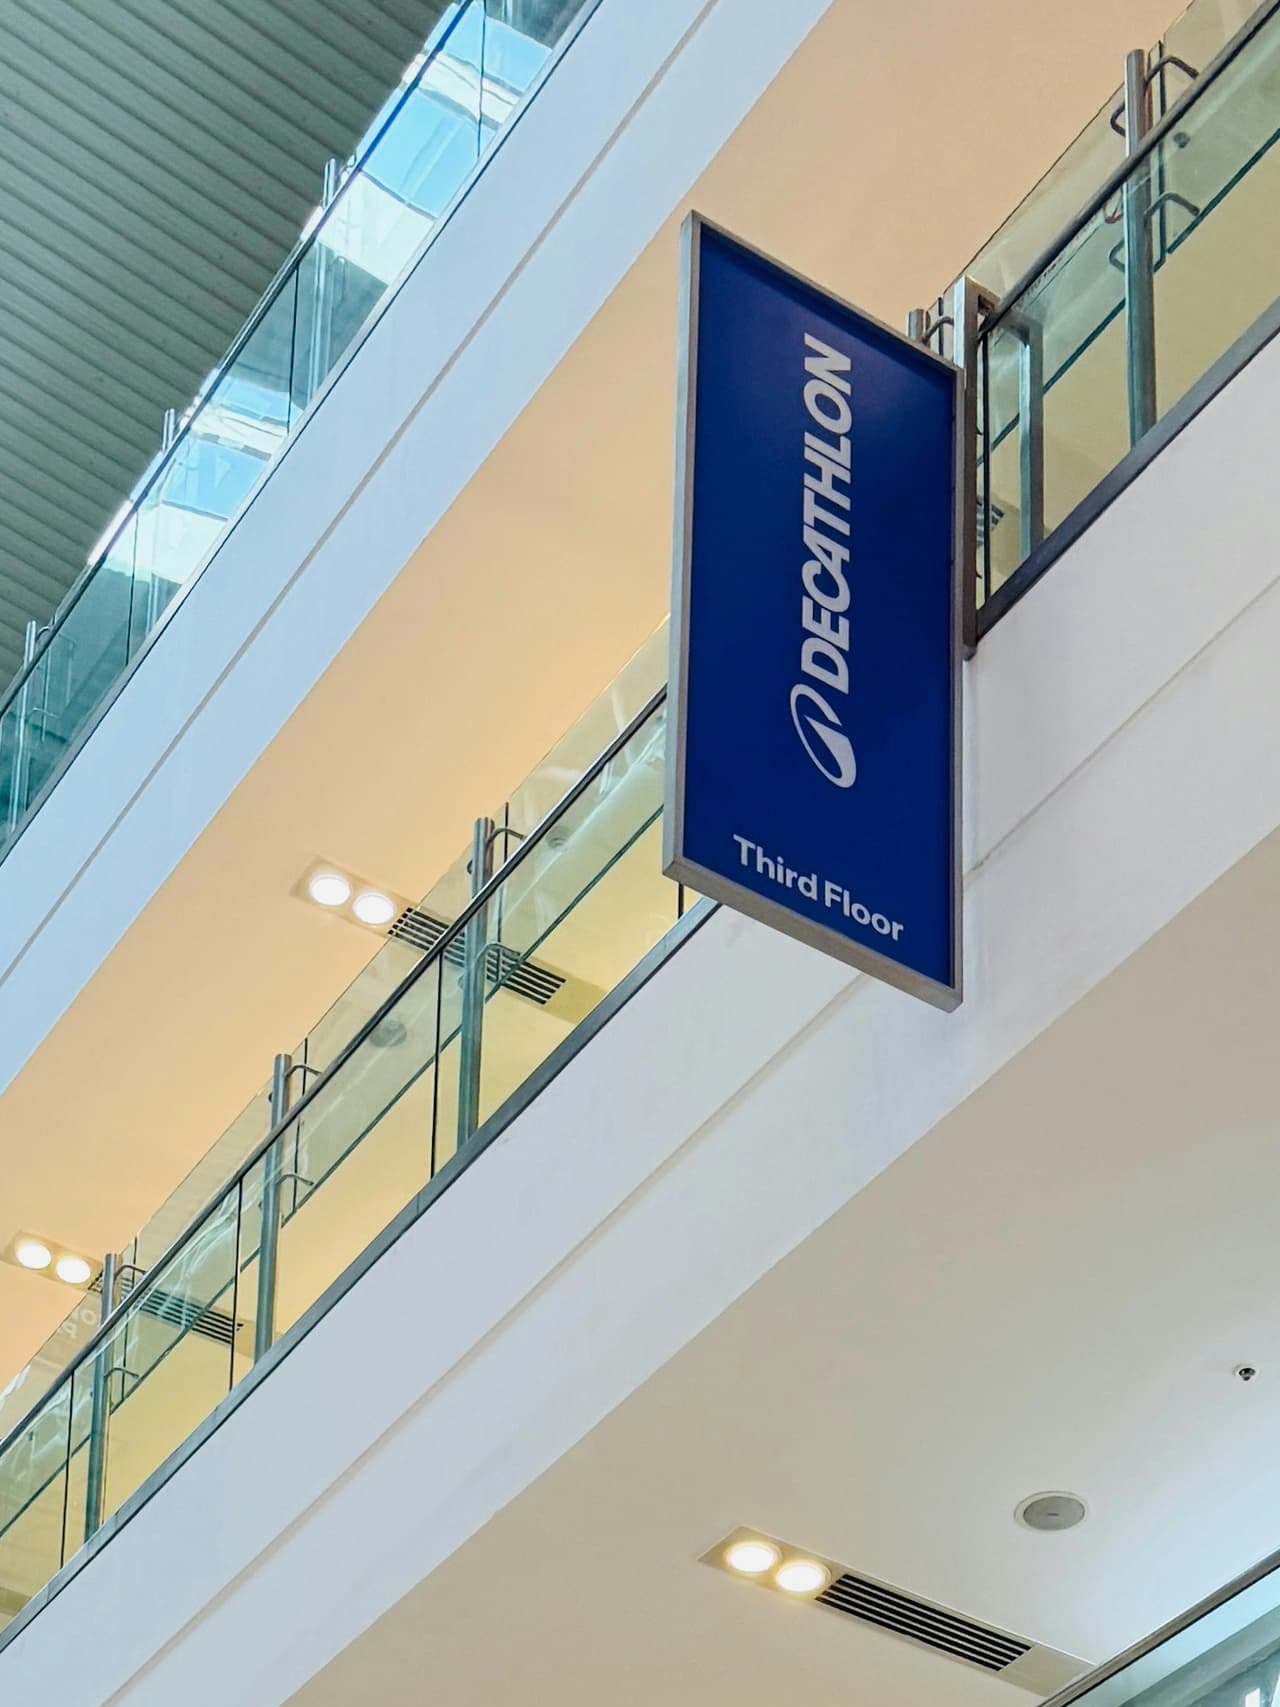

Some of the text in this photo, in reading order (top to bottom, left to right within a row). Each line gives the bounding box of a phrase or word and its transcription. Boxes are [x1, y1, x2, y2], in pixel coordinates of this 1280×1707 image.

[801, 333, 852, 694] DECATHLON
[733, 834, 904, 943] Third Floor
